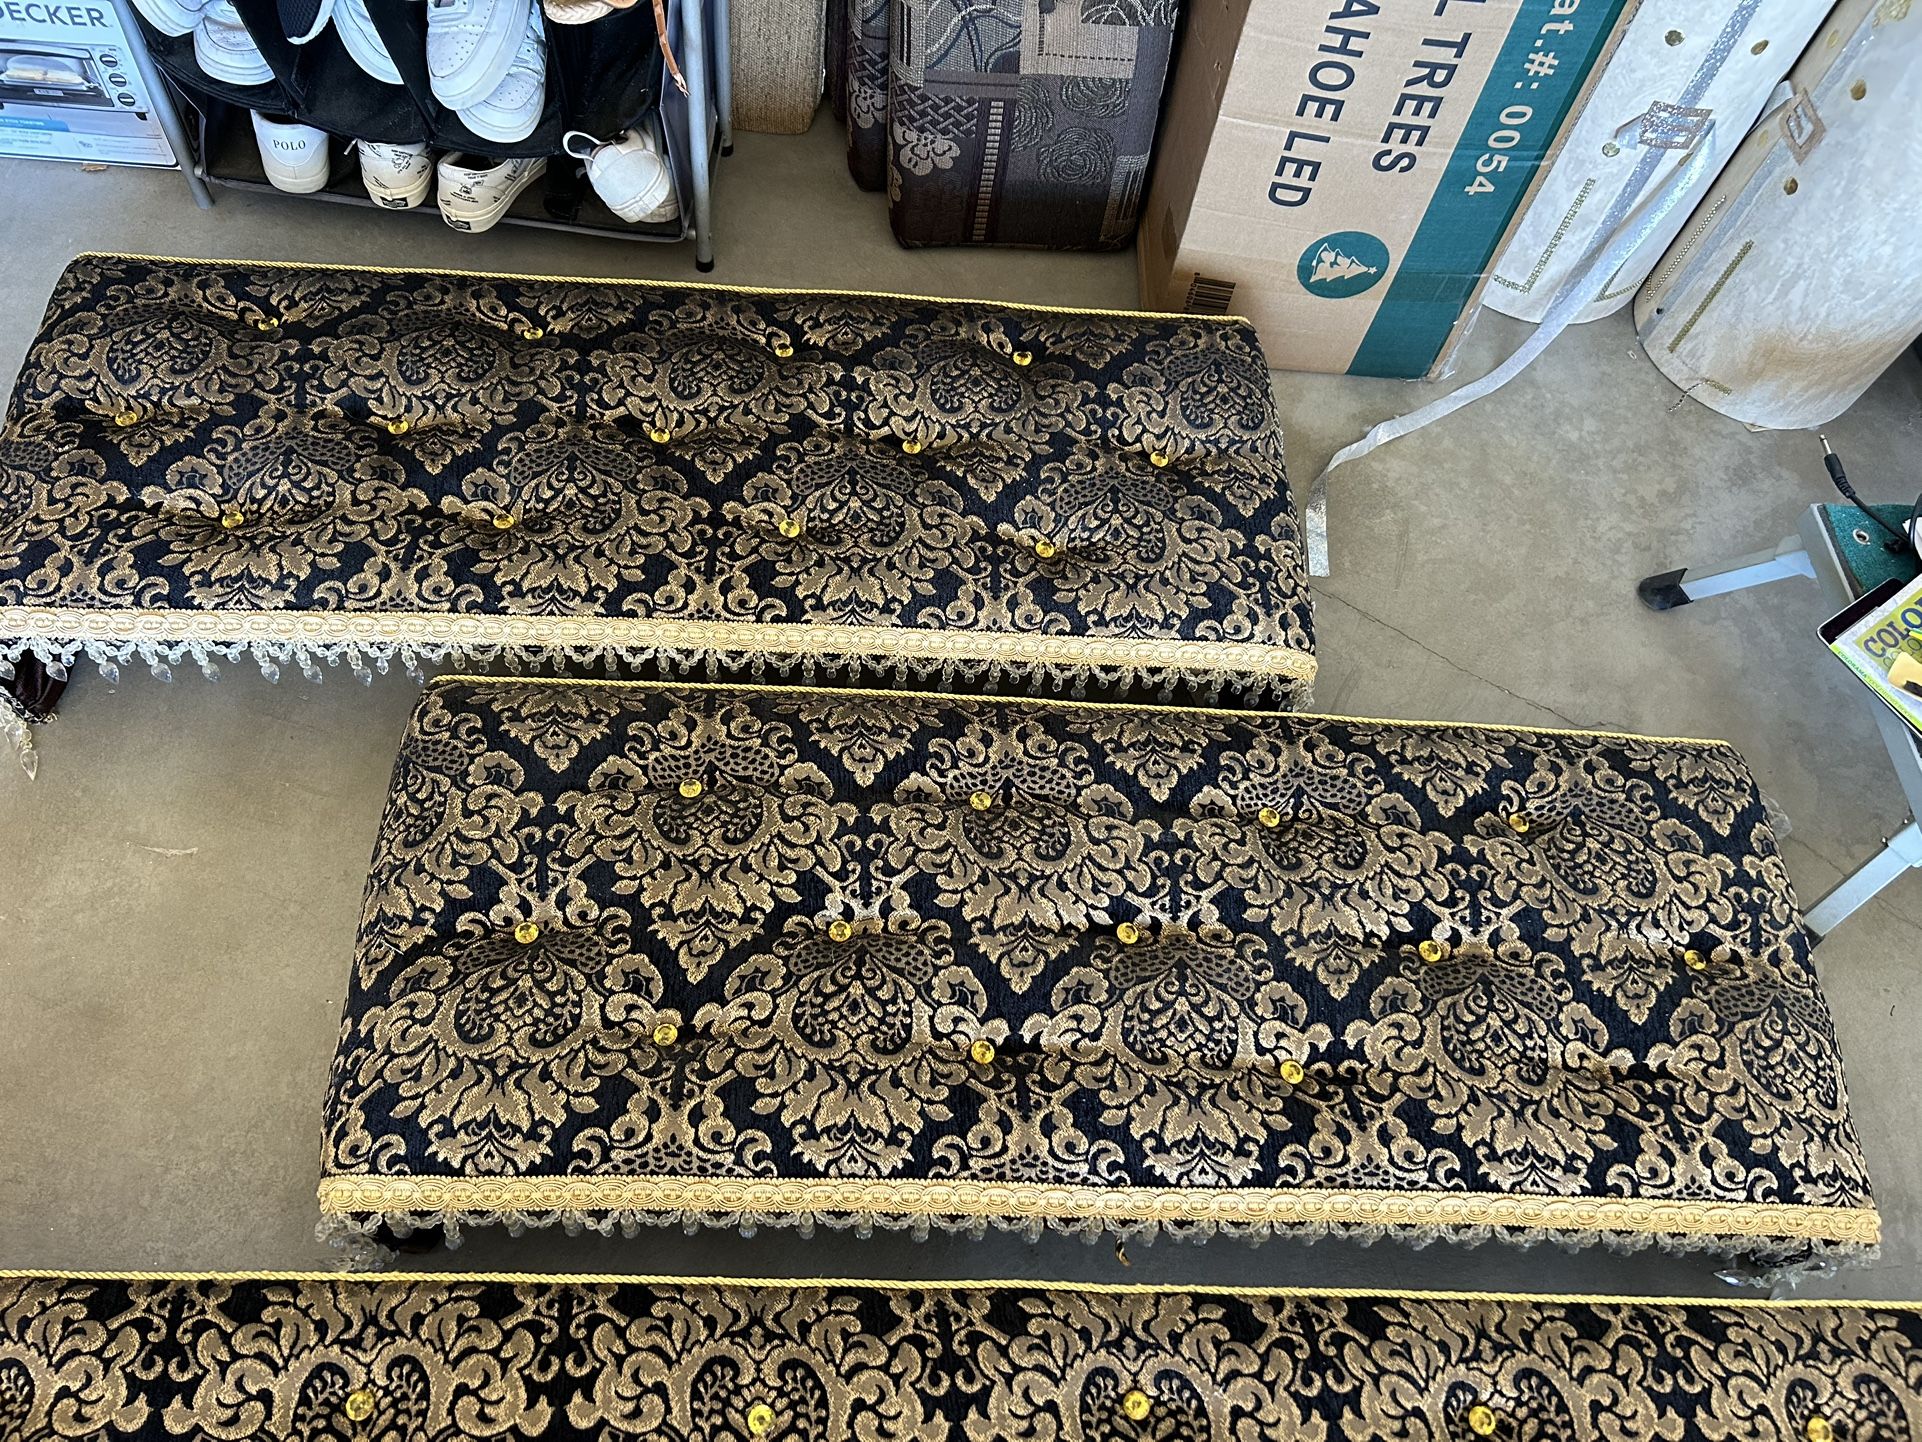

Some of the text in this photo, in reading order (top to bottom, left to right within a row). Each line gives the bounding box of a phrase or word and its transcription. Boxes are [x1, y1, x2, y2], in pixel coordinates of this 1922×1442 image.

[0, 1, 109, 28] ECKER
[1371, 32, 1473, 173] TREES
[273, 139, 306, 151] POLO
[1267, 130, 1331, 207] LED
[1464, 105, 1533, 195] 0054
[1863, 597, 1922, 658] COLO
